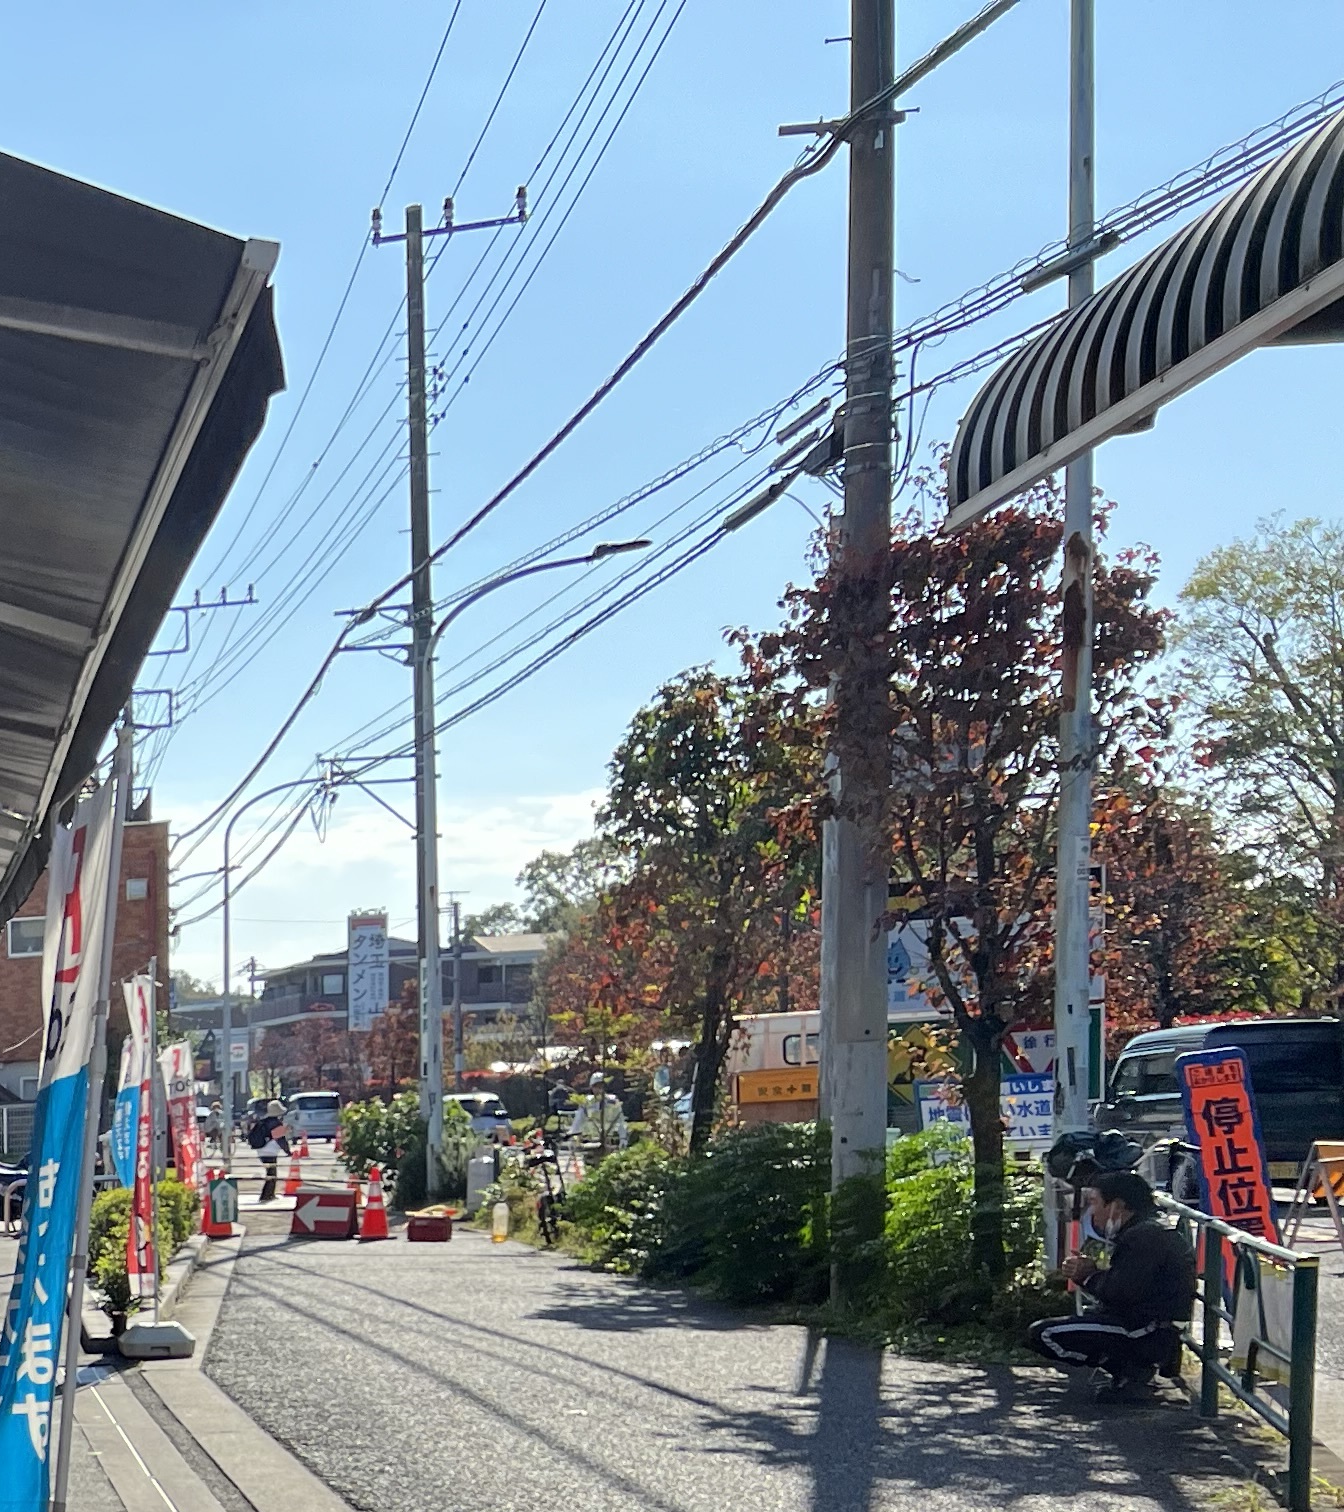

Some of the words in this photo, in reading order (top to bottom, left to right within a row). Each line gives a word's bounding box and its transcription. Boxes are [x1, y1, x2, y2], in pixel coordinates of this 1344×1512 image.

[352, 934, 368, 1002] タンメン
[1023, 1035, 1055, 1050] 徐行
[1201, 1096, 1266, 1237] 停止位置
